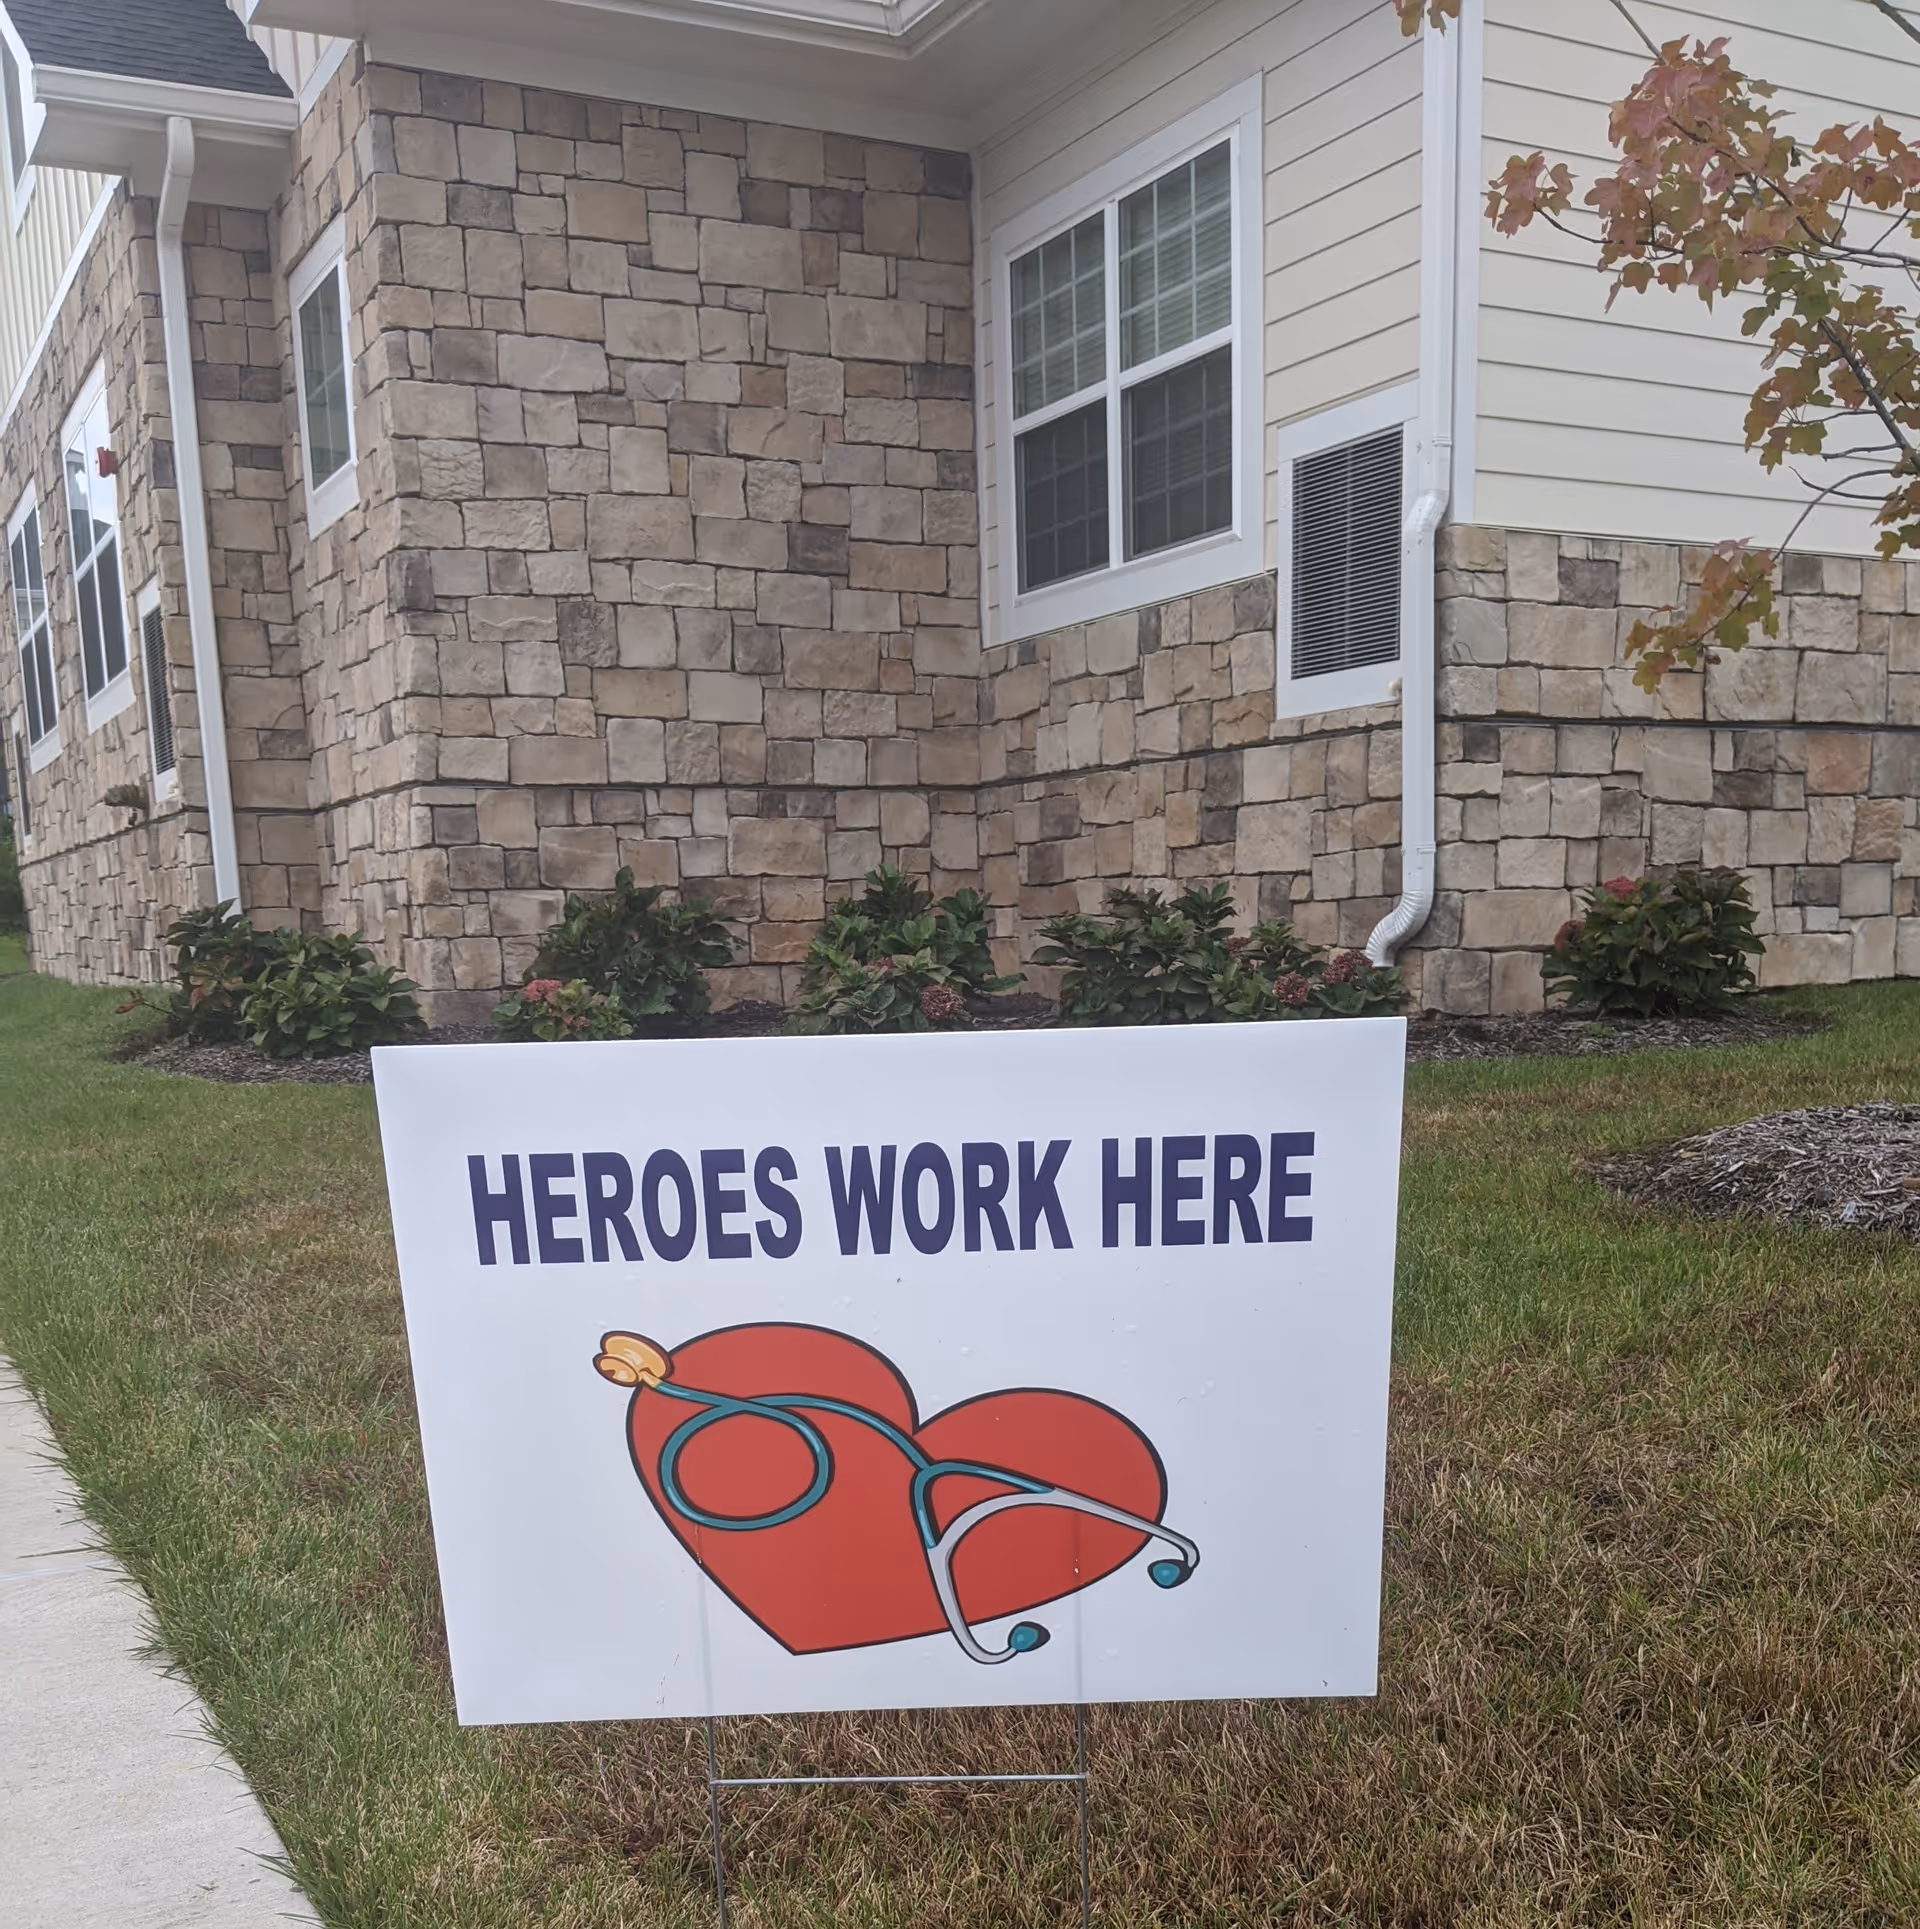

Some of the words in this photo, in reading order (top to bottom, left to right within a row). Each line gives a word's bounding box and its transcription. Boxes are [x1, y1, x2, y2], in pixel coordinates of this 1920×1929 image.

[467, 1146, 803, 1265] HEROES
[824, 1140, 1074, 1256] WORK
[1102, 1132, 1316, 1248] HERE
